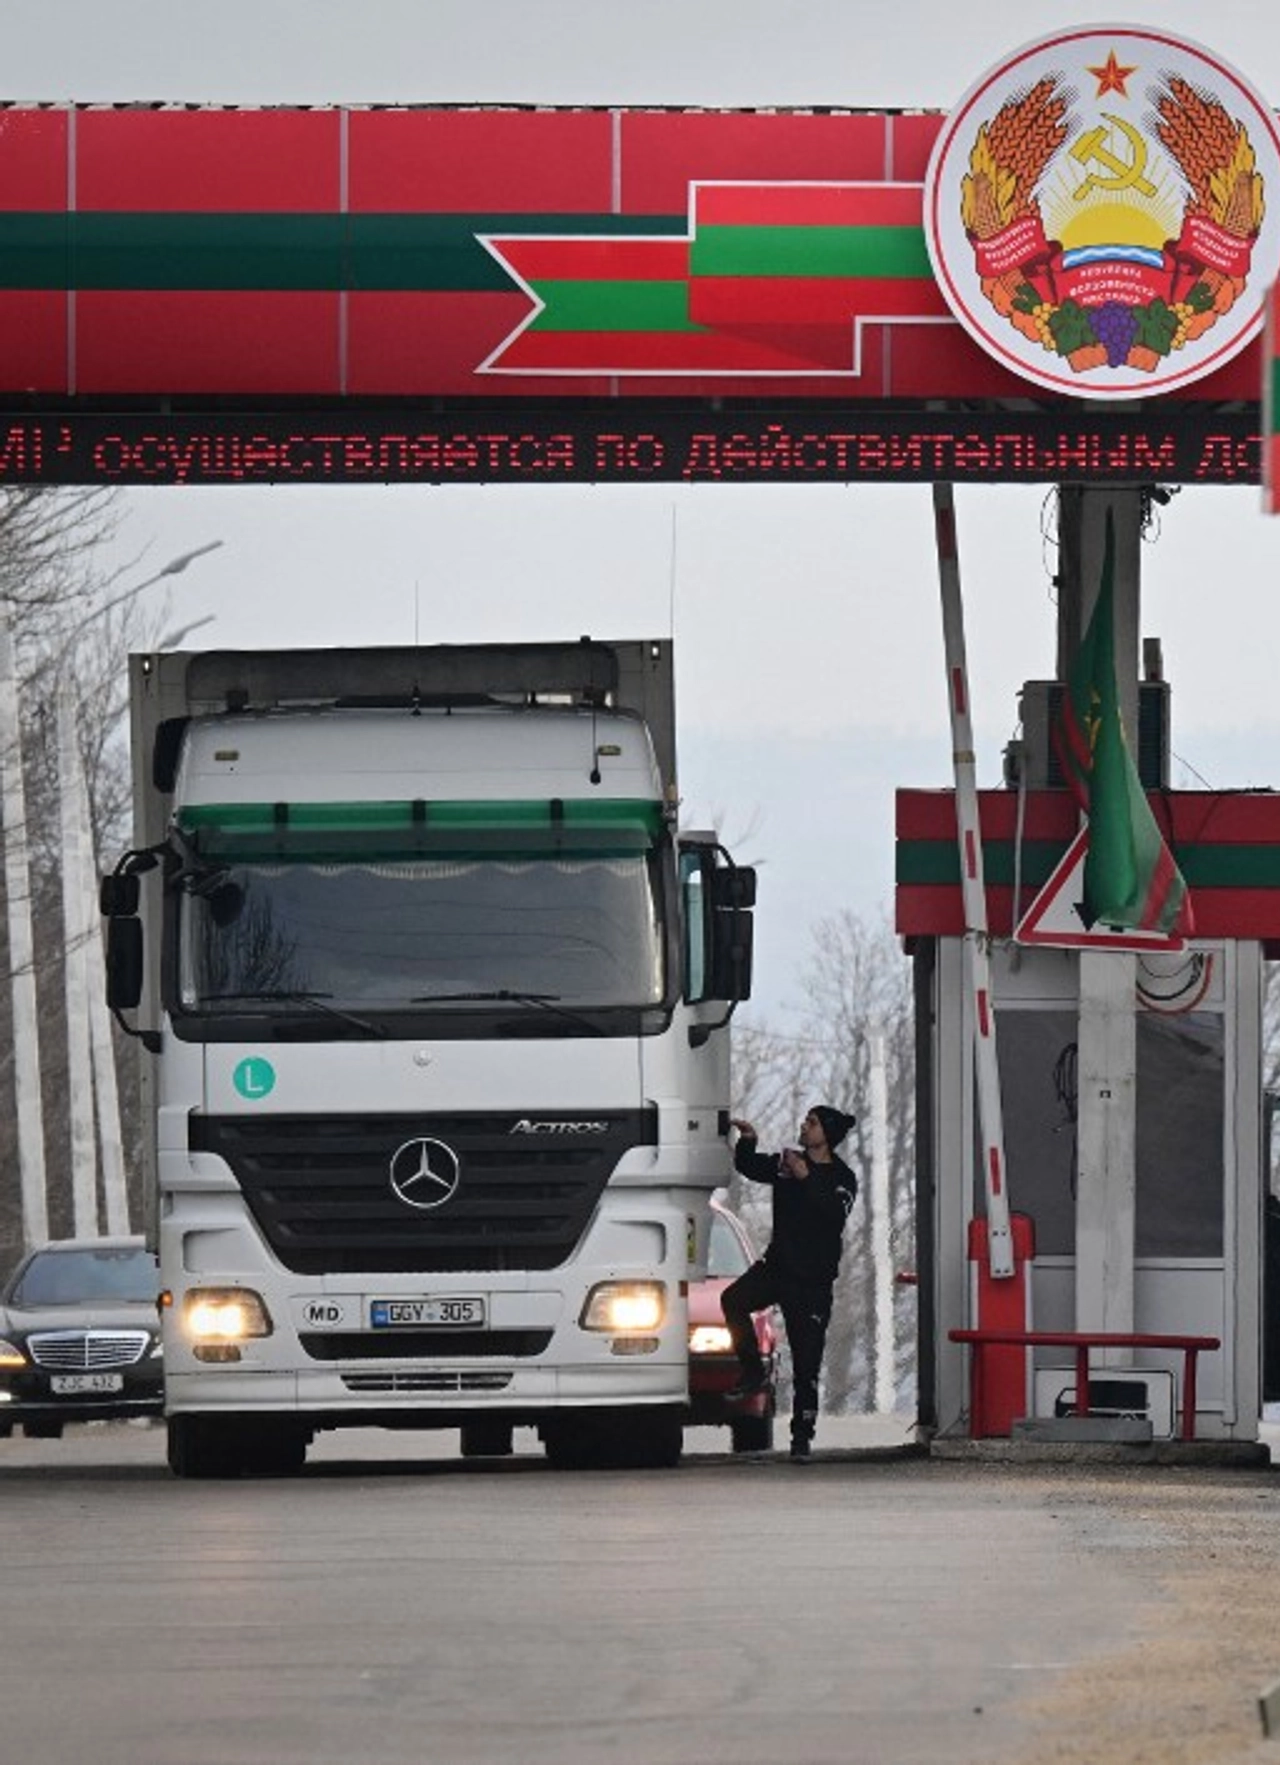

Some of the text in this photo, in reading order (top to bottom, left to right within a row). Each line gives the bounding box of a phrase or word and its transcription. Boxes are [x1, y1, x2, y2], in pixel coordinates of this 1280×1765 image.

[94, 434, 575, 484] осуществляется
[596, 434, 663, 474] по
[683, 424, 1175, 477] действительным
[244, 1064, 264, 1093] L
[309, 1306, 339, 1321] MD
[389, 1304, 424, 1322] GGY
[439, 1302, 474, 1322] 305
